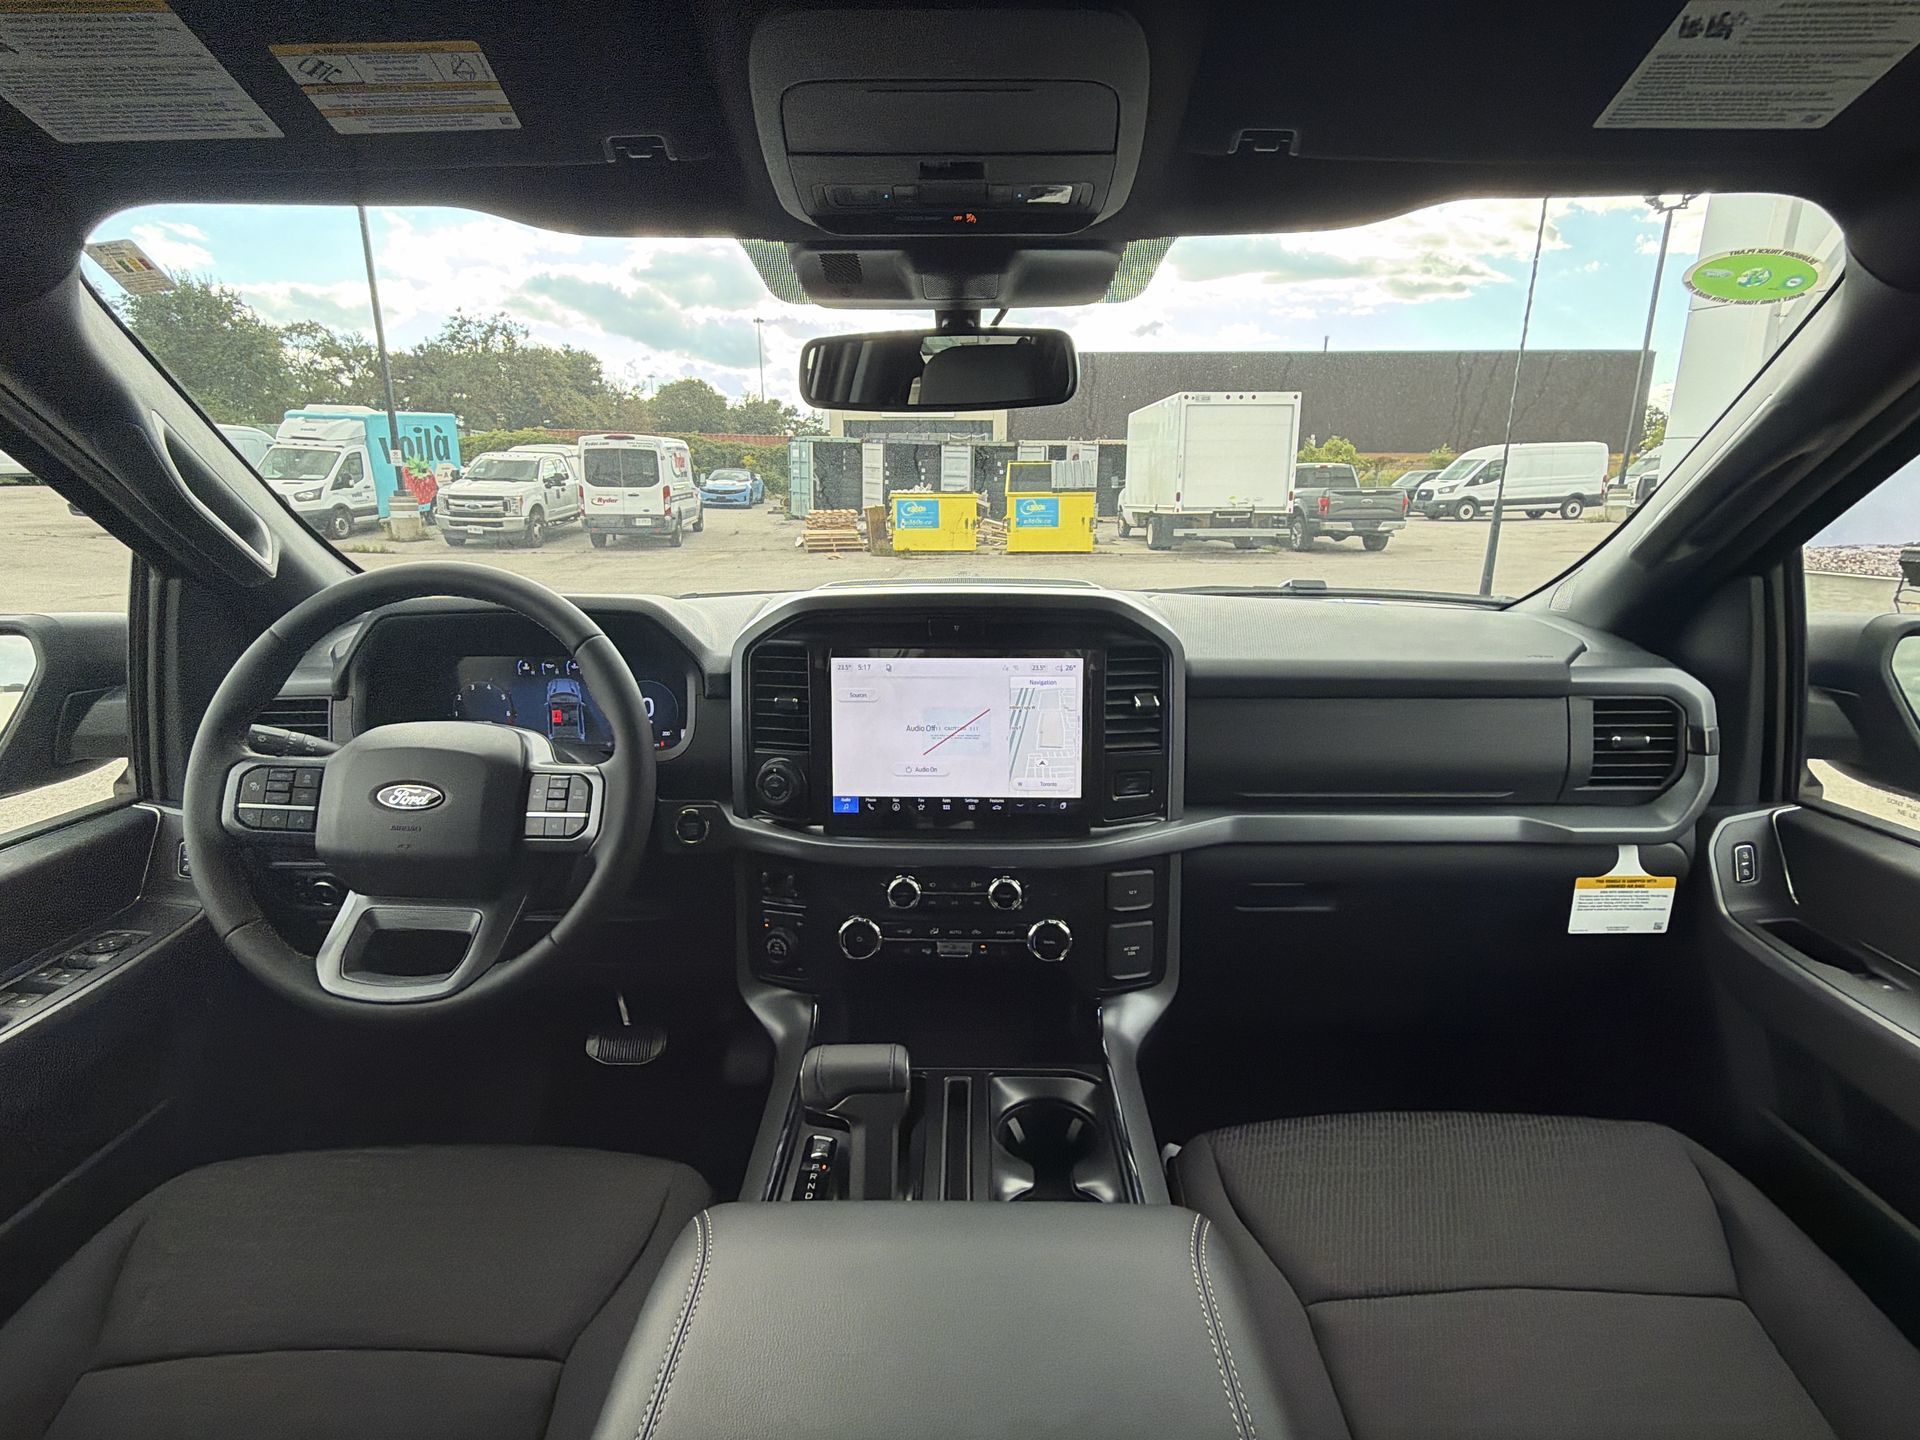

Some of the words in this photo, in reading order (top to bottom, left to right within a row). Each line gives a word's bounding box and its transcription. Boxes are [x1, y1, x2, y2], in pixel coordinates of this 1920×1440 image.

[906, 724, 925, 732] Audio
[388, 788, 431, 805] Ford
[1886, 797, 1904, 807] SONT
